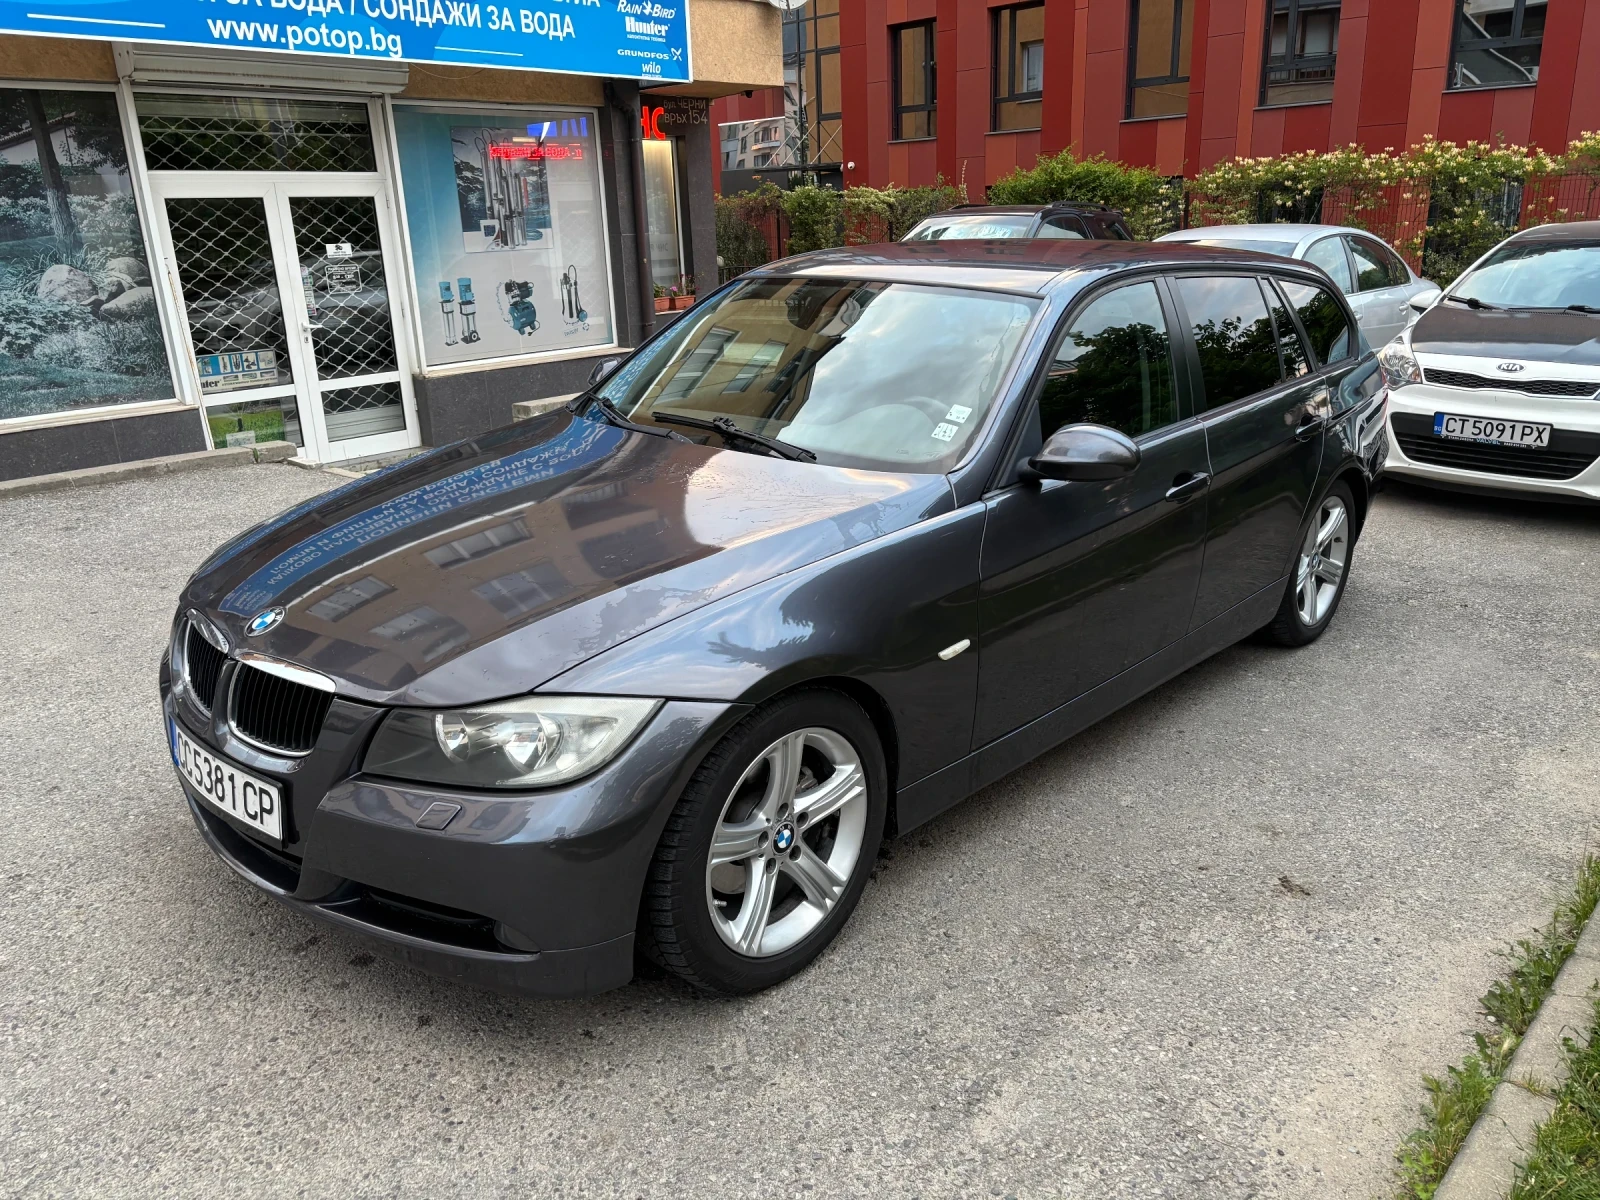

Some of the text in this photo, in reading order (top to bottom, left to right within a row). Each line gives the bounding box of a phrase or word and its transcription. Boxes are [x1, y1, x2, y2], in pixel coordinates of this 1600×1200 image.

[364, 0, 482, 28] СОНДАЖИ
[487, 5, 516, 32] ЗА
[520, 9, 576, 41] ВОДА
[625, 16, 669, 36] Hunter
[206, 18, 402, 58] www.potop.bg
[617, 48, 670, 60] GRUNDFOS
[642, 61, 661, 74] wilo
[688, 110, 708, 124] 154
[1500, 363, 1520, 371] KIA
